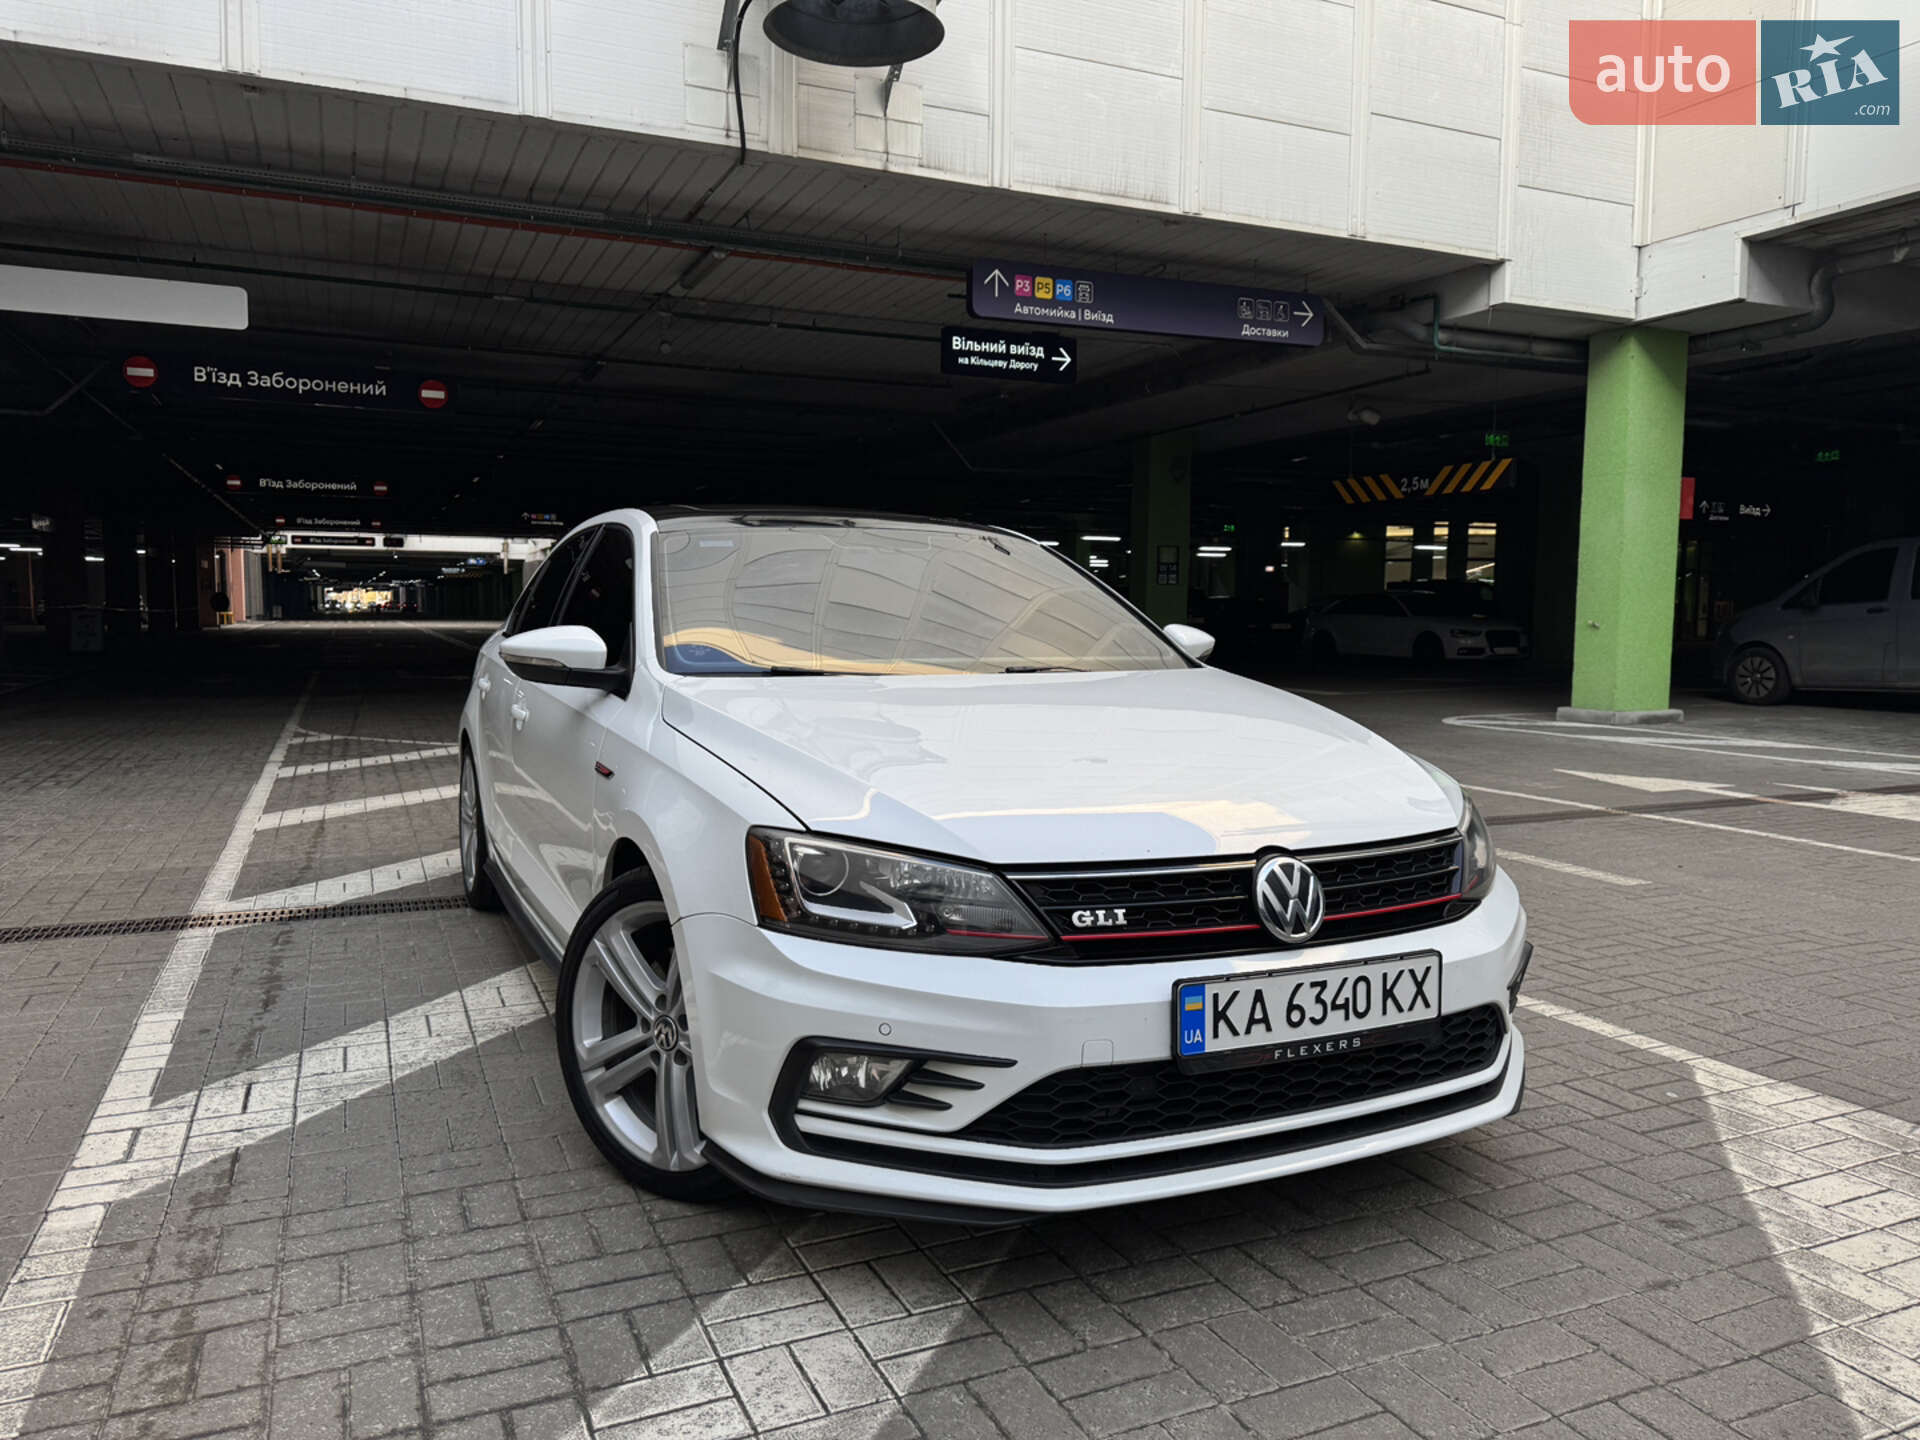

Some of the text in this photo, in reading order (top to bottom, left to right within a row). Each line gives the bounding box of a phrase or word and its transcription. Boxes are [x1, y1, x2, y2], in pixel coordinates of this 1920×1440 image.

[1015, 279, 1072, 297] P3 P5 P6
[1014, 302, 1115, 324] Автомийка Виїзд
[1240, 323, 1289, 338] Доставки
[952, 335, 1045, 359] Вільний виїзд
[193, 365, 387, 396] В'їзд Заборонений
[286, 479, 357, 492] Заборонений
[1071, 908, 1128, 928] GLI
[1212, 965, 1432, 1039] KA 6340 KX
[1184, 1028, 1203, 1045] UA
[1274, 1037, 1362, 1060] FLEXERS
